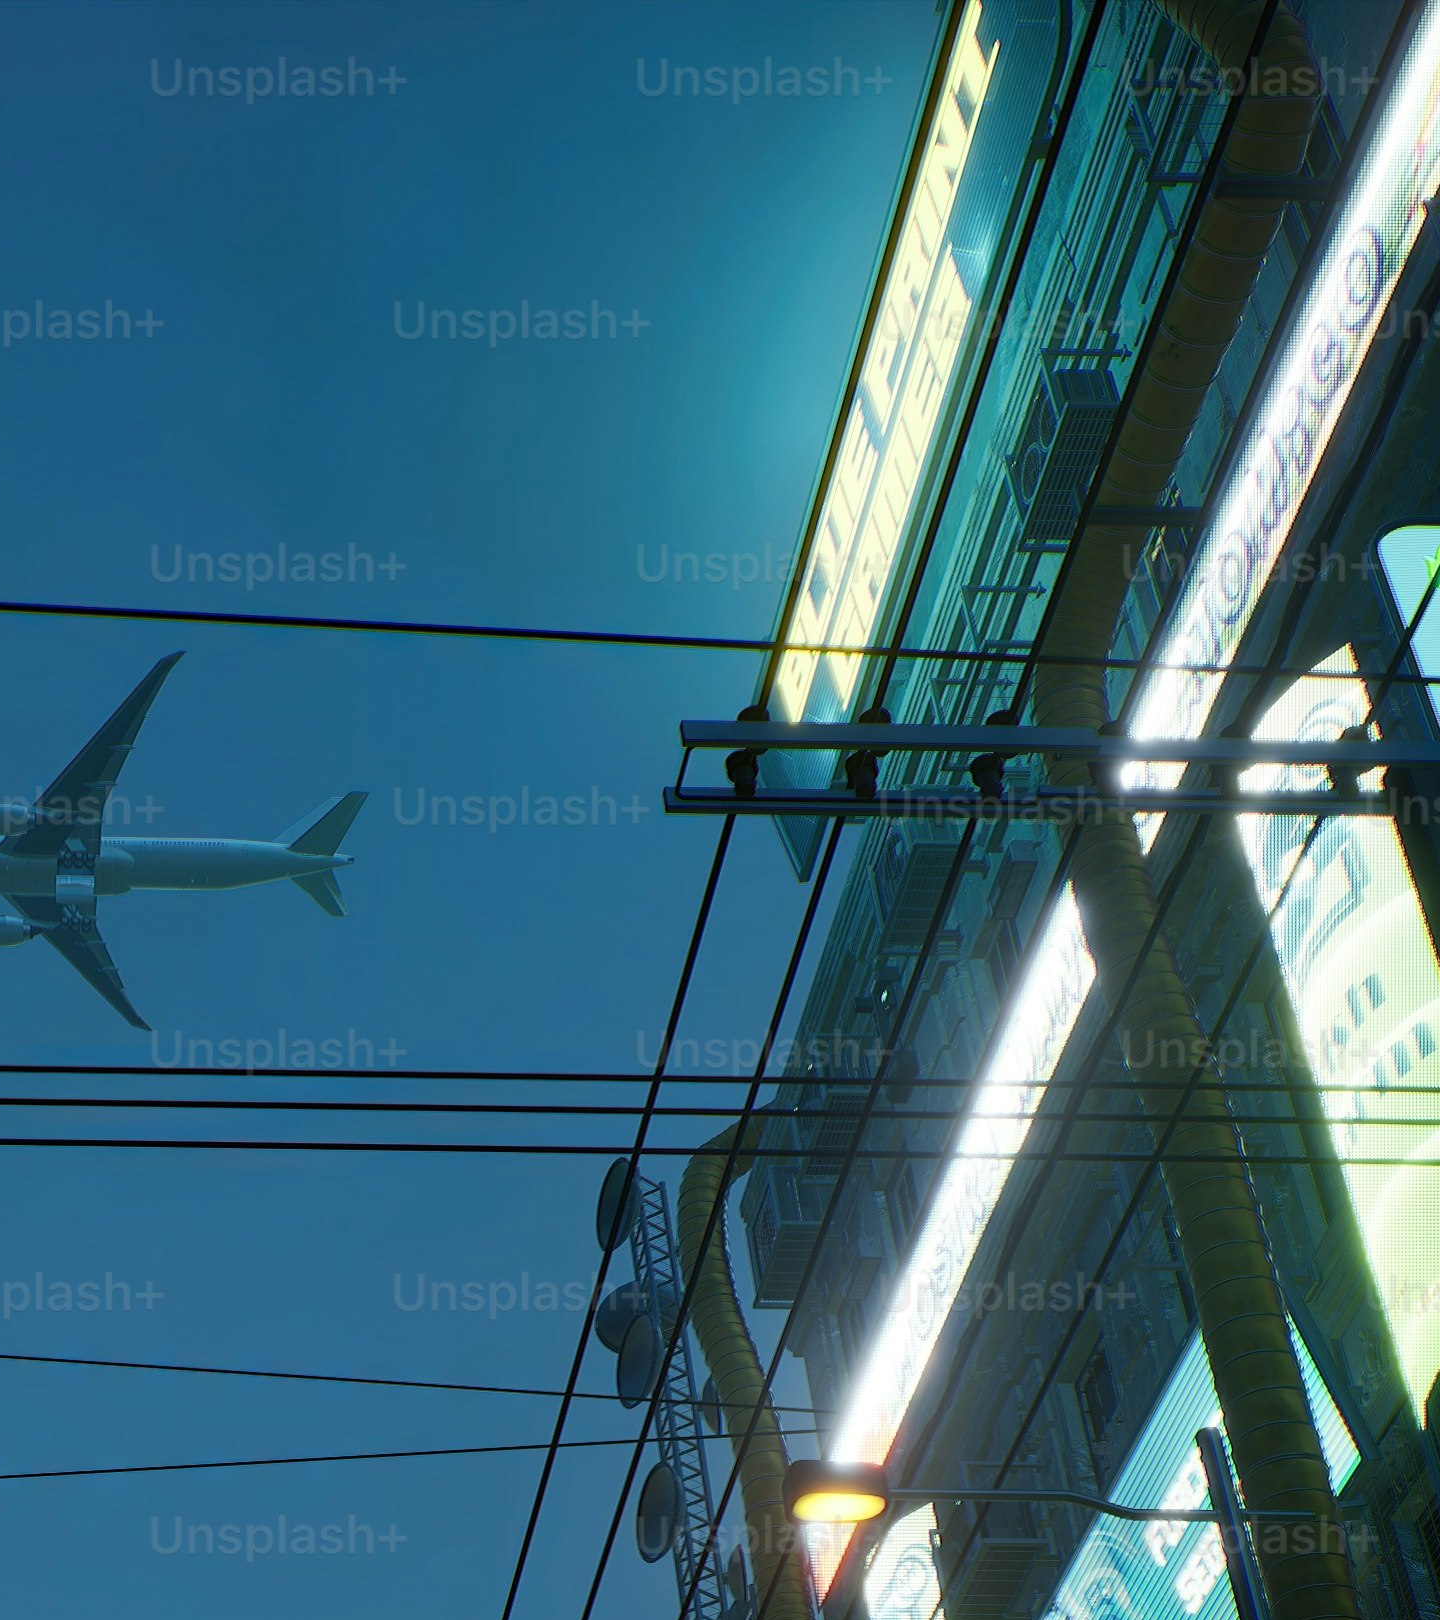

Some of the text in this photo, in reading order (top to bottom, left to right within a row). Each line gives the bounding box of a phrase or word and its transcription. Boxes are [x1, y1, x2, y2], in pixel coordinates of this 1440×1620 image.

[777, 0, 1001, 723] BLUE PRINT
[826, 242, 972, 711] GAMES
